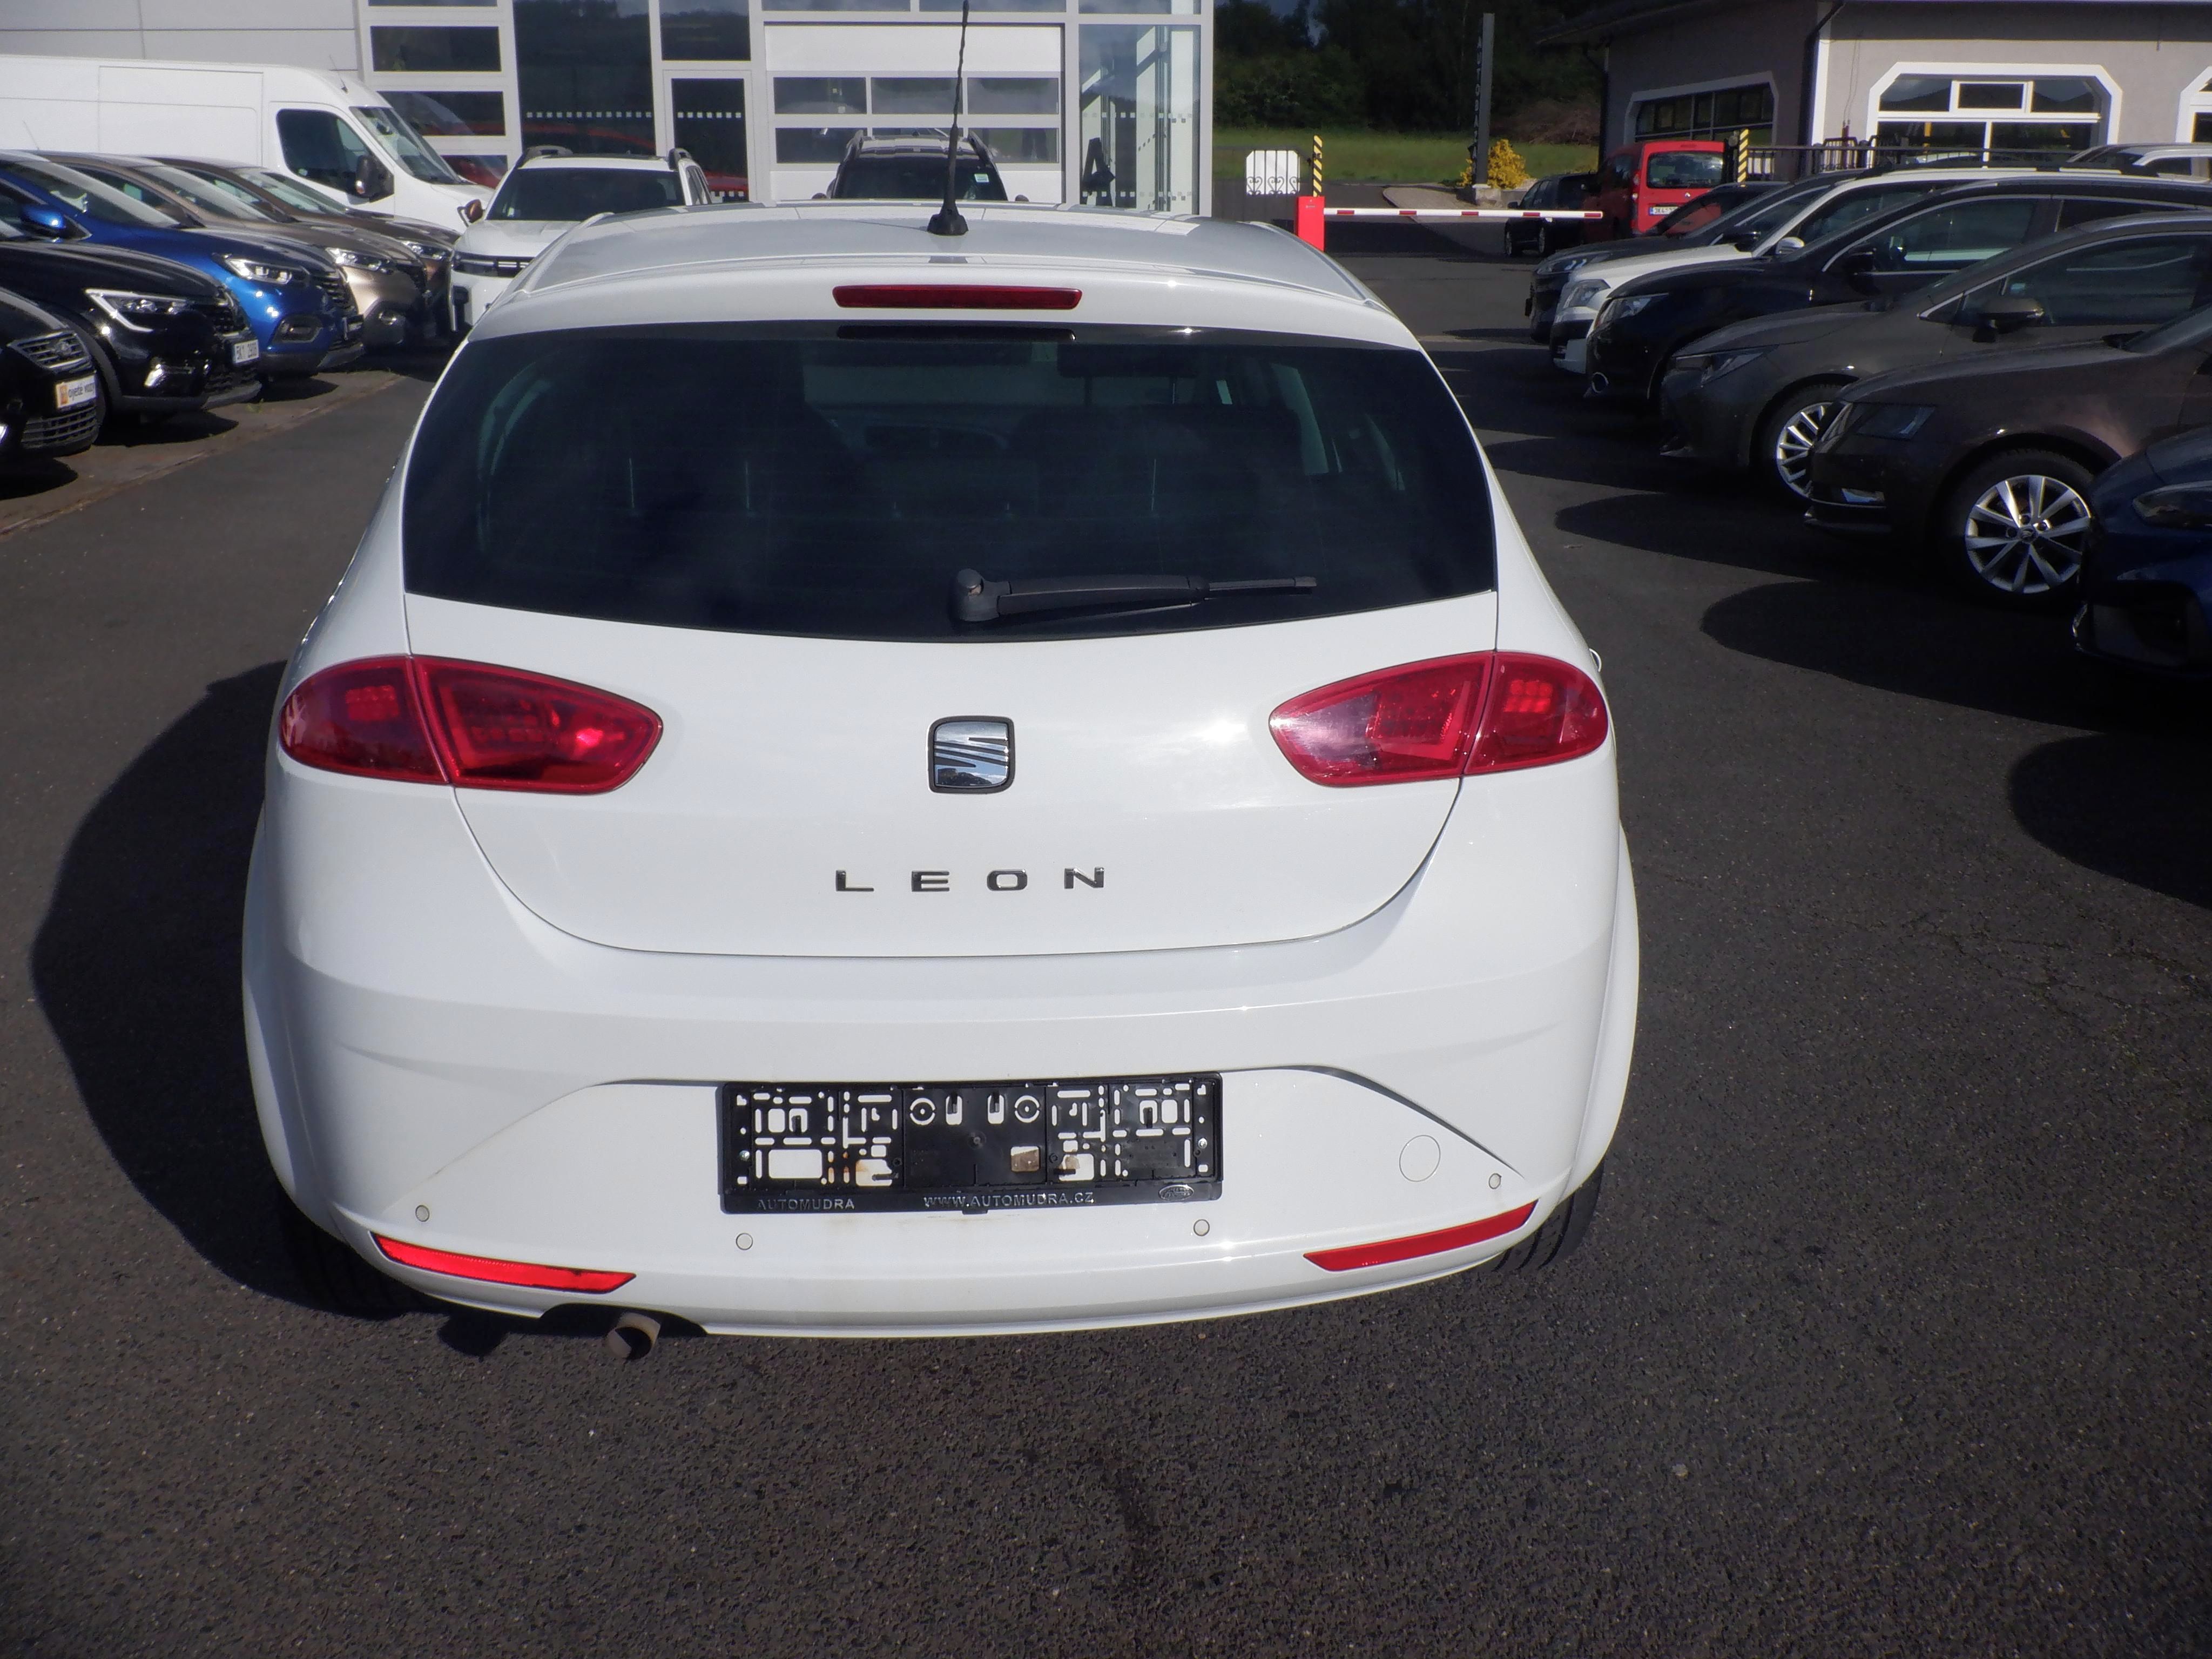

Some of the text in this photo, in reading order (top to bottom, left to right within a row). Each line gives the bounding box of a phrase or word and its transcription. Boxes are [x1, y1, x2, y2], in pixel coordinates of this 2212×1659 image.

[835, 867, 1105, 892] LEON
[758, 1191, 1094, 1210] AUTOMUDRA WWW.AUTOMUDRA.CZ
